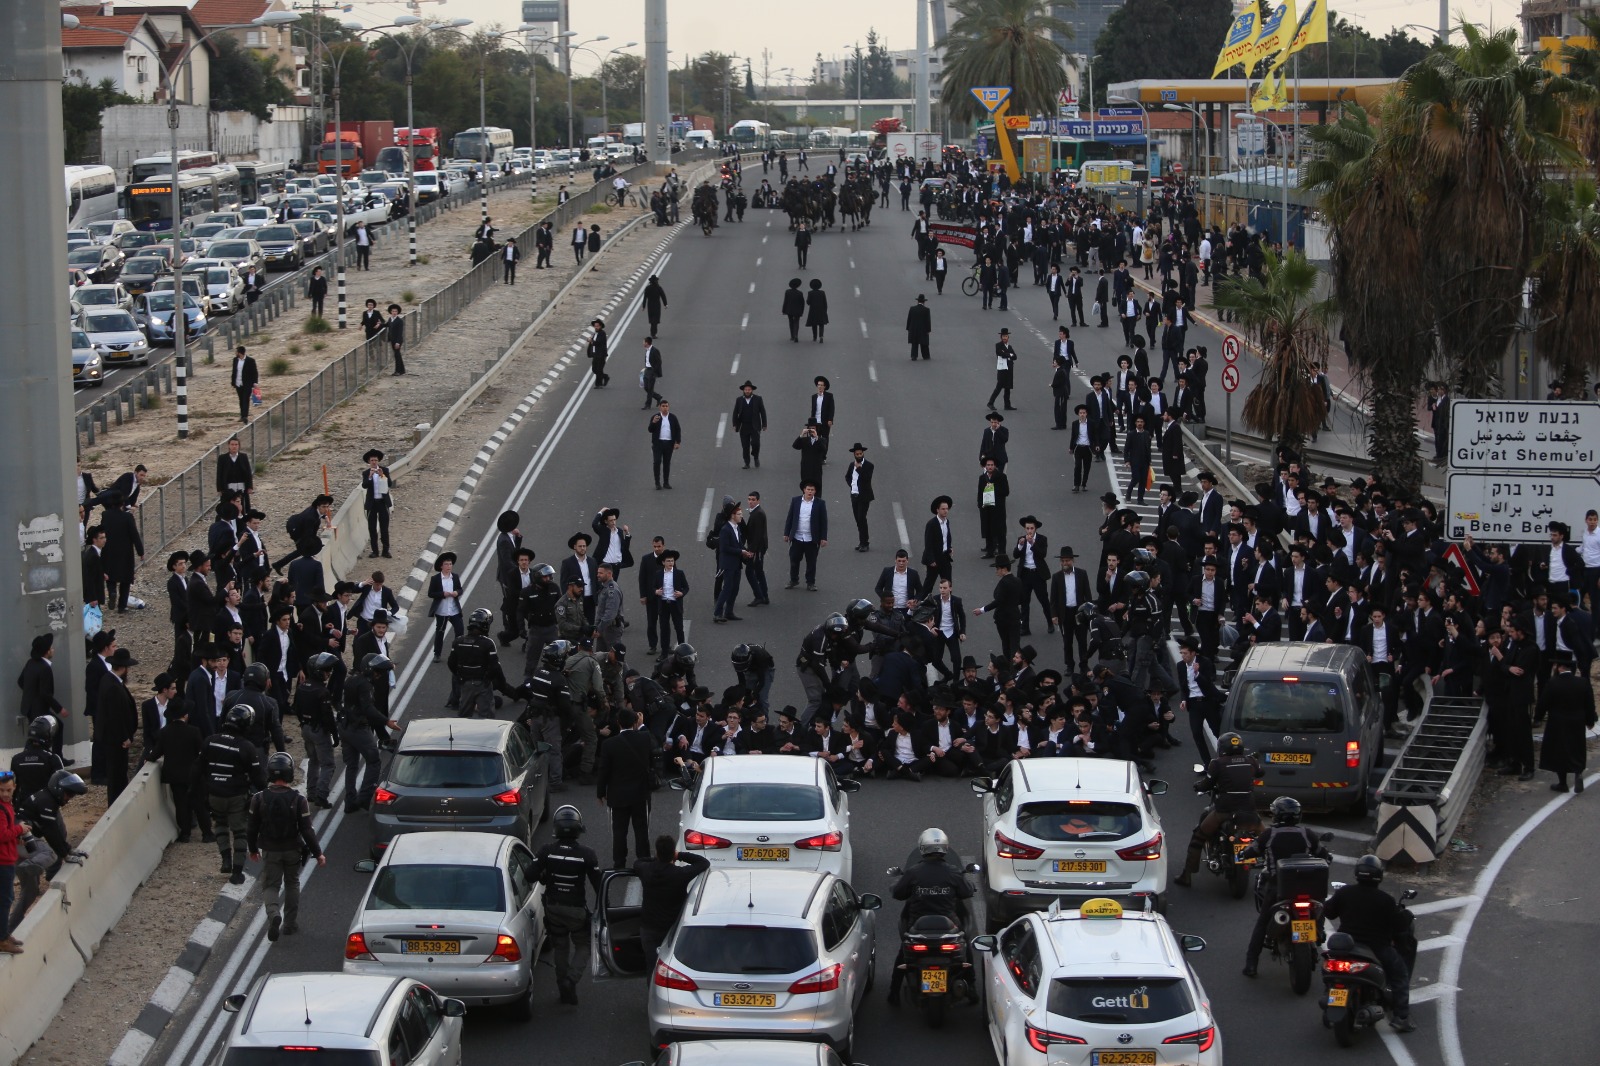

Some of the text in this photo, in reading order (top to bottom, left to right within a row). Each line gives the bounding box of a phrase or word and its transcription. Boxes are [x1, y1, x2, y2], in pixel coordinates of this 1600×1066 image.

[982, 90, 999, 101] פז
[1160, 89, 1178, 101] פז
[1098, 124, 1129, 134] פנינת
[1475, 408, 1579, 424] גבעת שמואל
[1470, 428, 1525, 446] شموئيل
[1457, 448, 1593, 462] Giv'at Shemu'el
[1492, 483, 1554, 497] בני ברק
[1491, 502, 1522, 518] براك
[1531, 504, 1553, 519] بني
[1470, 520, 1512, 533] Bene
[1091, 996, 1129, 1008] Gett
